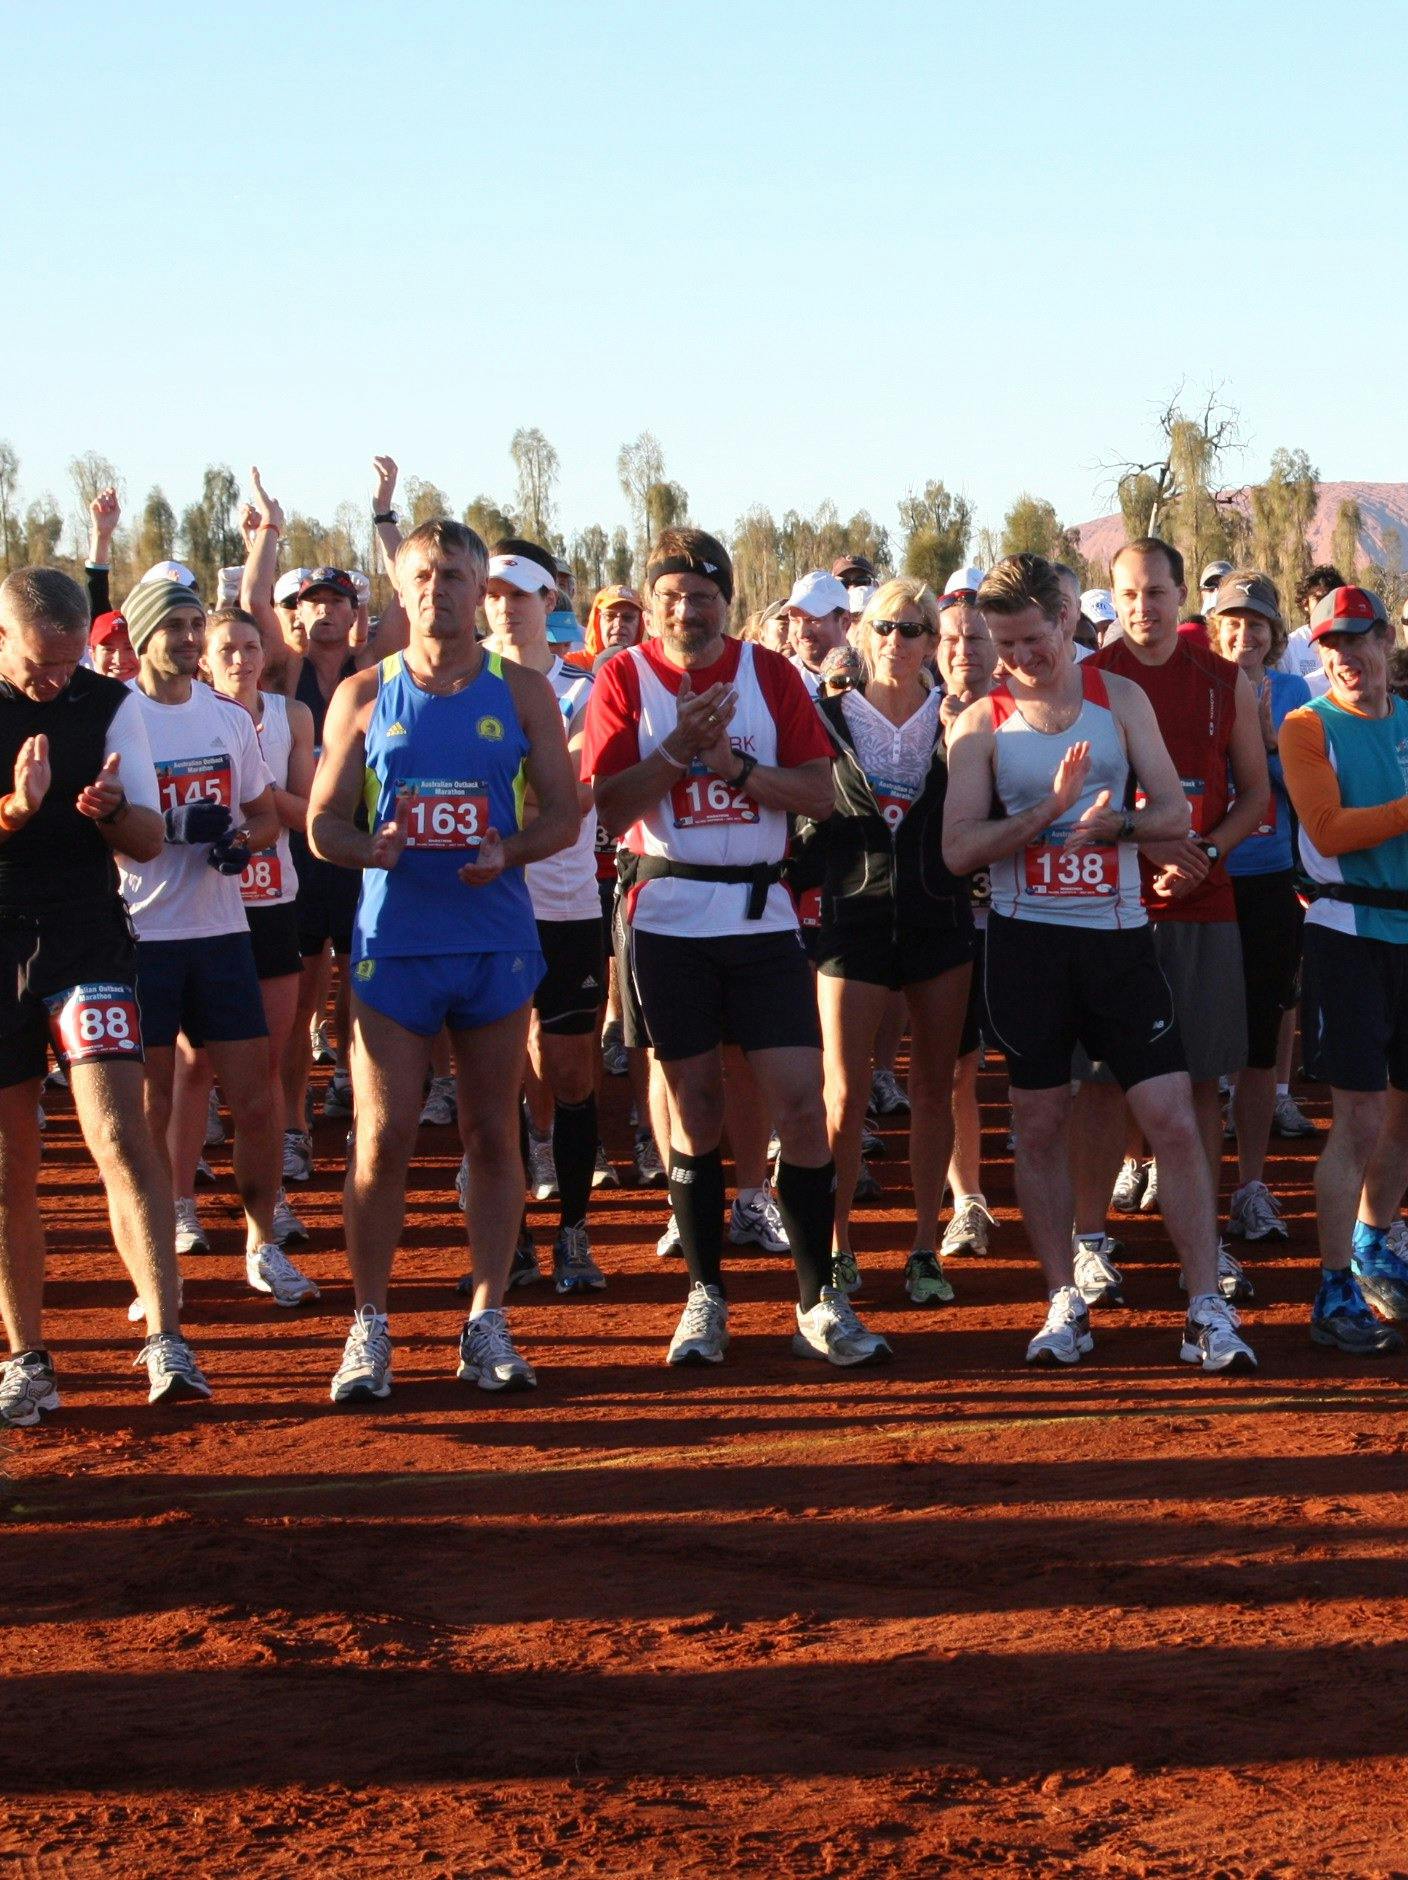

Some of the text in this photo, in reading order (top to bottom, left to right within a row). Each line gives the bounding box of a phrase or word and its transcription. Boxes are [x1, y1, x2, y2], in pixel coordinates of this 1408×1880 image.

[173, 756, 223, 769] Australian Outback
[187, 765, 214, 774] Marathon
[162, 778, 222, 809] 145
[420, 780, 479, 789] Australian Outback
[434, 788, 466, 796] Marathon
[685, 779, 750, 812] 162
[411, 802, 478, 835] 163
[883, 804, 904, 833] 9
[1036, 852, 1104, 884] 138
[78, 993, 112, 1003] Marathon
[98, 985, 125, 993] Outback
[80, 1006, 130, 1041] 88
